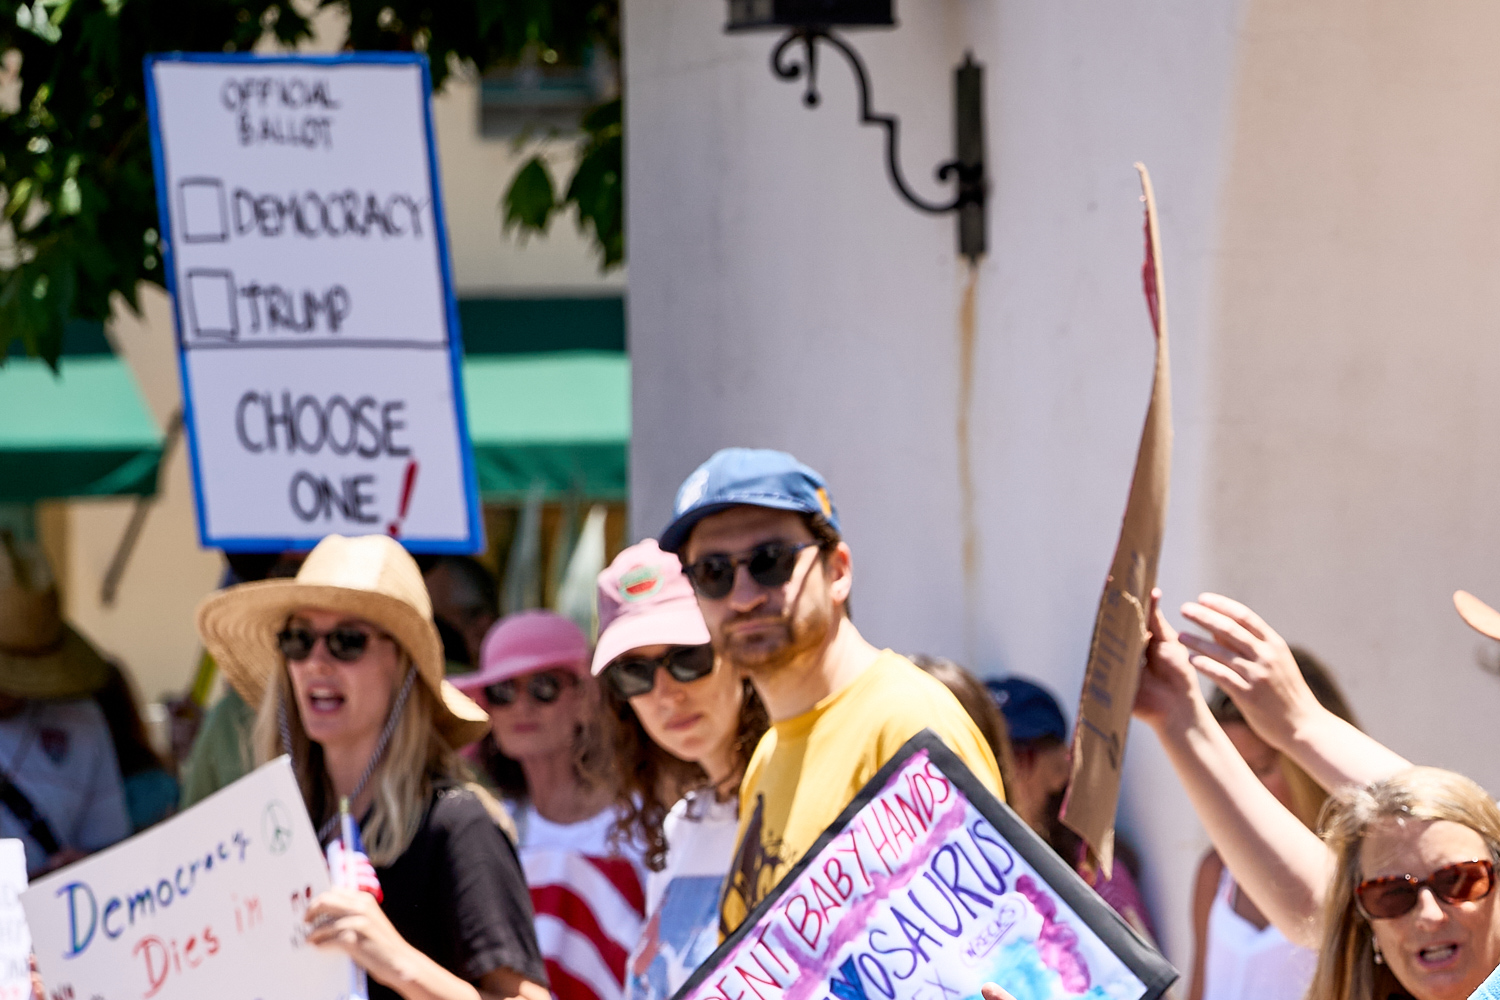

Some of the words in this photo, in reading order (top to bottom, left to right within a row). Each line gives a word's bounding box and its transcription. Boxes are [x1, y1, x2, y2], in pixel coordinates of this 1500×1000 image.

[221, 77, 341, 111] OFFICIAL
[238, 110, 334, 149] BALLOT
[233, 187, 431, 238] DEMOCRACY
[241, 280, 352, 334] TRUMP
[236, 391, 413, 458] CHOOSE
[785, 828, 872, 951] BABY
[869, 760, 951, 869] HANDS
[56, 831, 250, 960] Democracy
[132, 924, 221, 999] Dies
